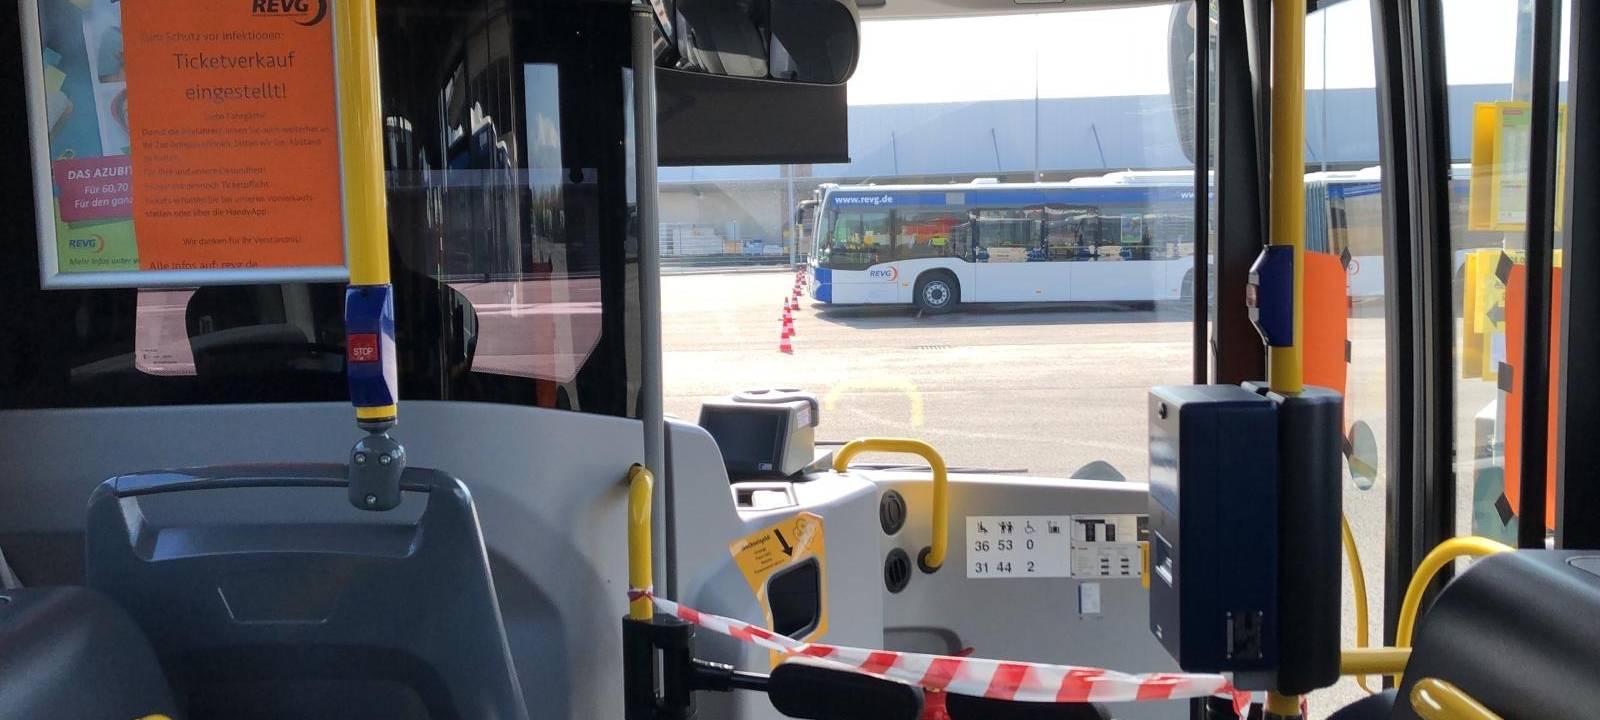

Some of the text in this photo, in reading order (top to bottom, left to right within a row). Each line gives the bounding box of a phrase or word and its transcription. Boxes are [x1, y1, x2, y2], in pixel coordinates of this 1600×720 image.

[252, 0, 309, 13] REVG
[166, 31, 200, 41] Schutz
[203, 33, 218, 41] vor
[173, 50, 296, 70] Ticketverkauf
[184, 82, 287, 104] eingestellt!
[67, 169, 91, 180] DAS
[84, 184, 99, 194] Für
[74, 198, 89, 208] Für
[91, 197, 110, 207] den
[834, 195, 894, 205] www.revg.de
[68, 239, 97, 249] REVG
[869, 269, 893, 279] REVG
[353, 346, 374, 356] STOP
[974, 538, 1034, 552] 36 53 0
[974, 560, 1035, 574] 31 44 2
